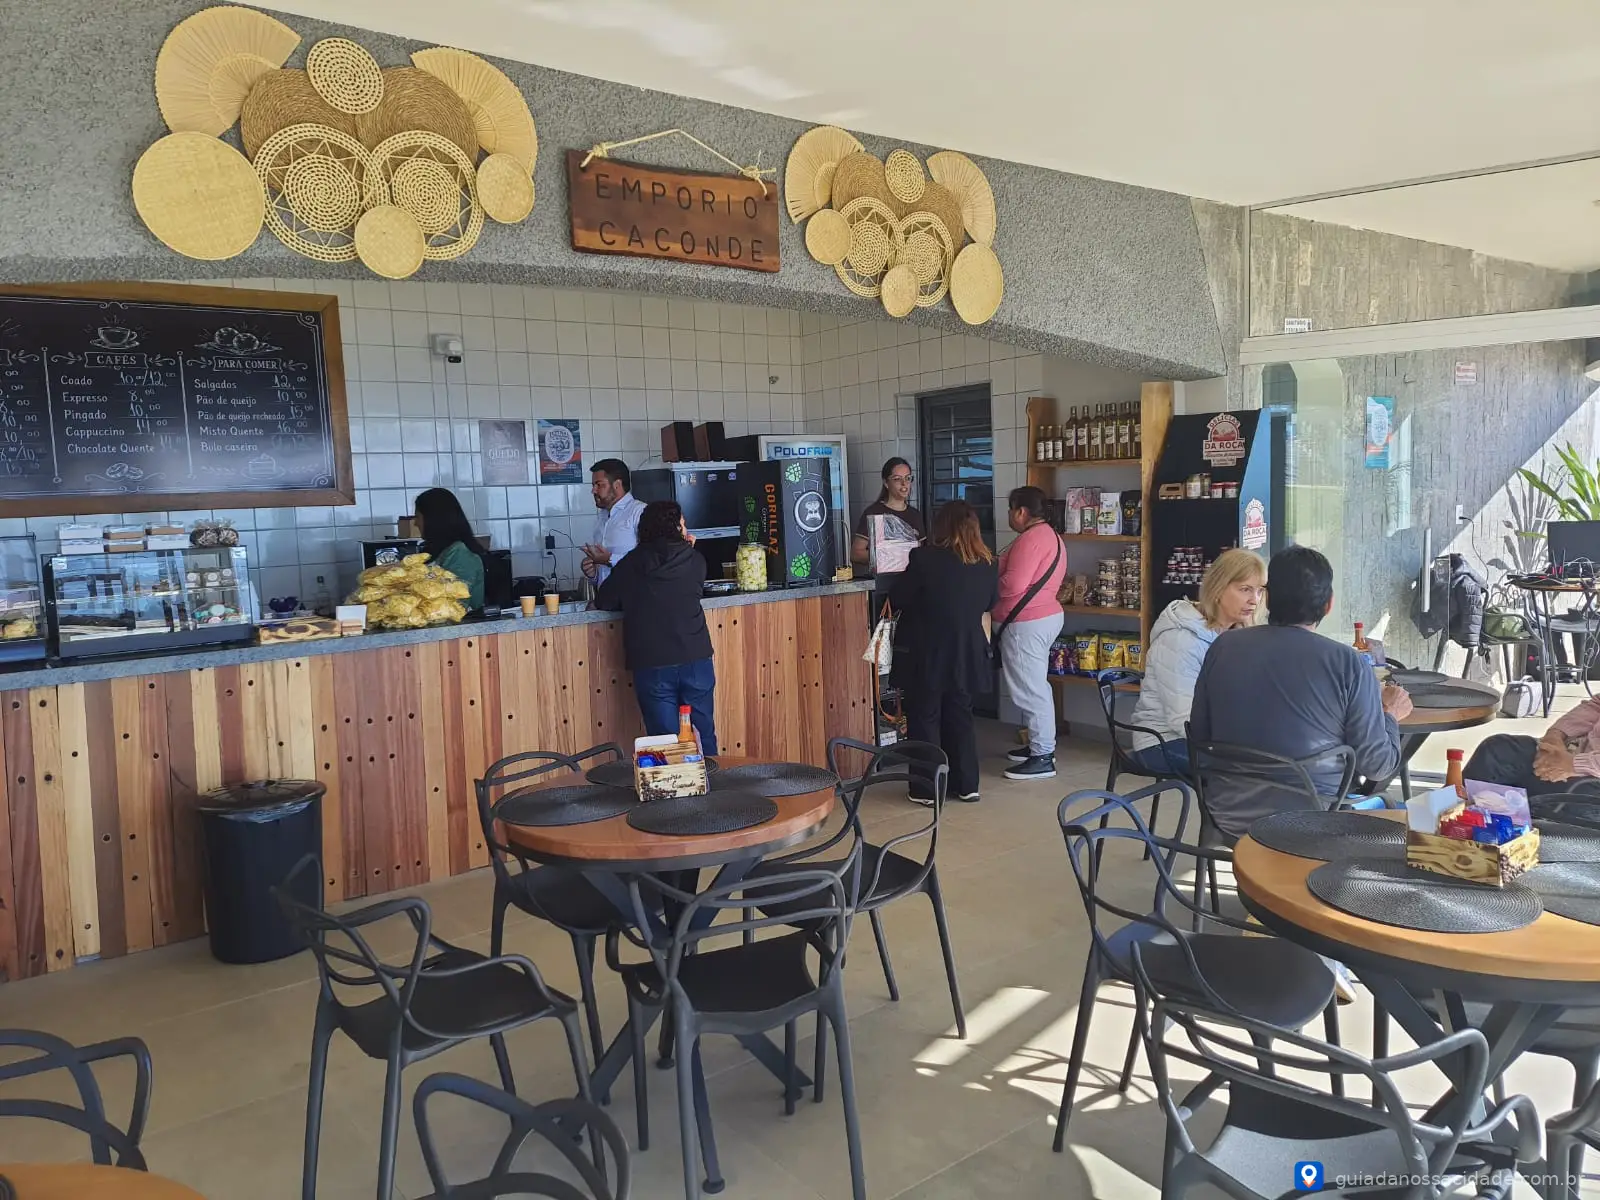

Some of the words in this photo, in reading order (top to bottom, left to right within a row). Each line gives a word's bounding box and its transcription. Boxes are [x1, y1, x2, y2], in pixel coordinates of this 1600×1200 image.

[595, 174, 758, 219] EMPORIO
[599, 221, 764, 263] CACONDE
[97, 354, 137, 365] CAFÉS
[218, 359, 242, 369] PARA
[245, 360, 277, 369] COMER
[60, 375, 93, 386] Coado
[194, 378, 237, 392] Salgados
[62, 391, 108, 405] Expresso
[196, 394, 214, 405] Pão
[216, 395, 229, 405] de
[230, 396, 257, 408] queijo
[64, 409, 107, 423] Pingado
[198, 410, 214, 420] Pão
[216, 410, 226, 420] de
[228, 411, 251, 422] queijo
[252, 411, 286, 421] recheado
[65, 426, 125, 439] Cappuccino
[200, 426, 227, 436] Misto
[229, 425, 265, 436] Quente
[67, 443, 117, 454] Chocolate
[120, 443, 155, 454] Quente
[225, 441, 258, 452] caseiro
[764, 483, 779, 555] GORILLAZ
